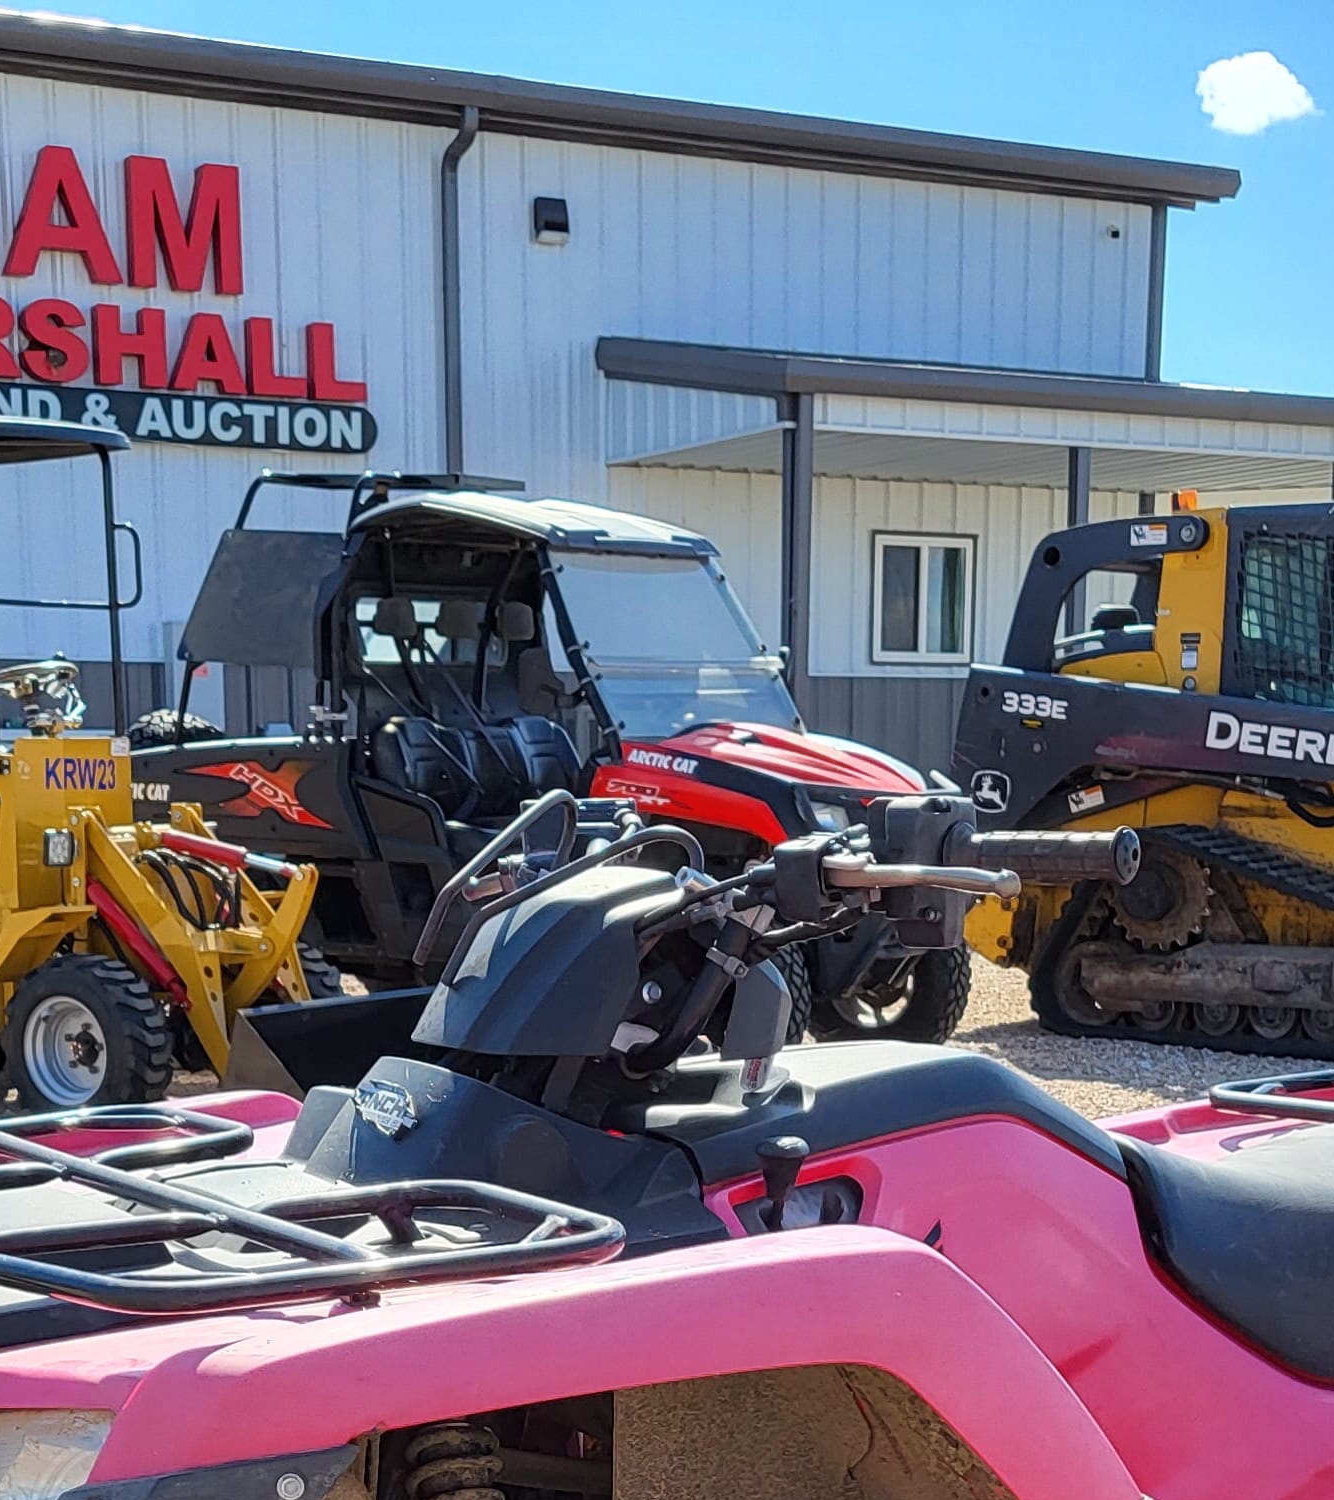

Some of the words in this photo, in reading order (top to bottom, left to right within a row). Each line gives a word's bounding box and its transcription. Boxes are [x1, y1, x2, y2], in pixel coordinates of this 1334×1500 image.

[81, 392, 117, 430] &
[136, 398, 363, 450] AUCTION
[1002, 691, 1069, 721] 333E
[44, 756, 116, 790] KRW23
[628, 748, 672, 769] ARCTIC
[672, 756, 699, 775] CAT
[146, 783, 170, 801] CAT
